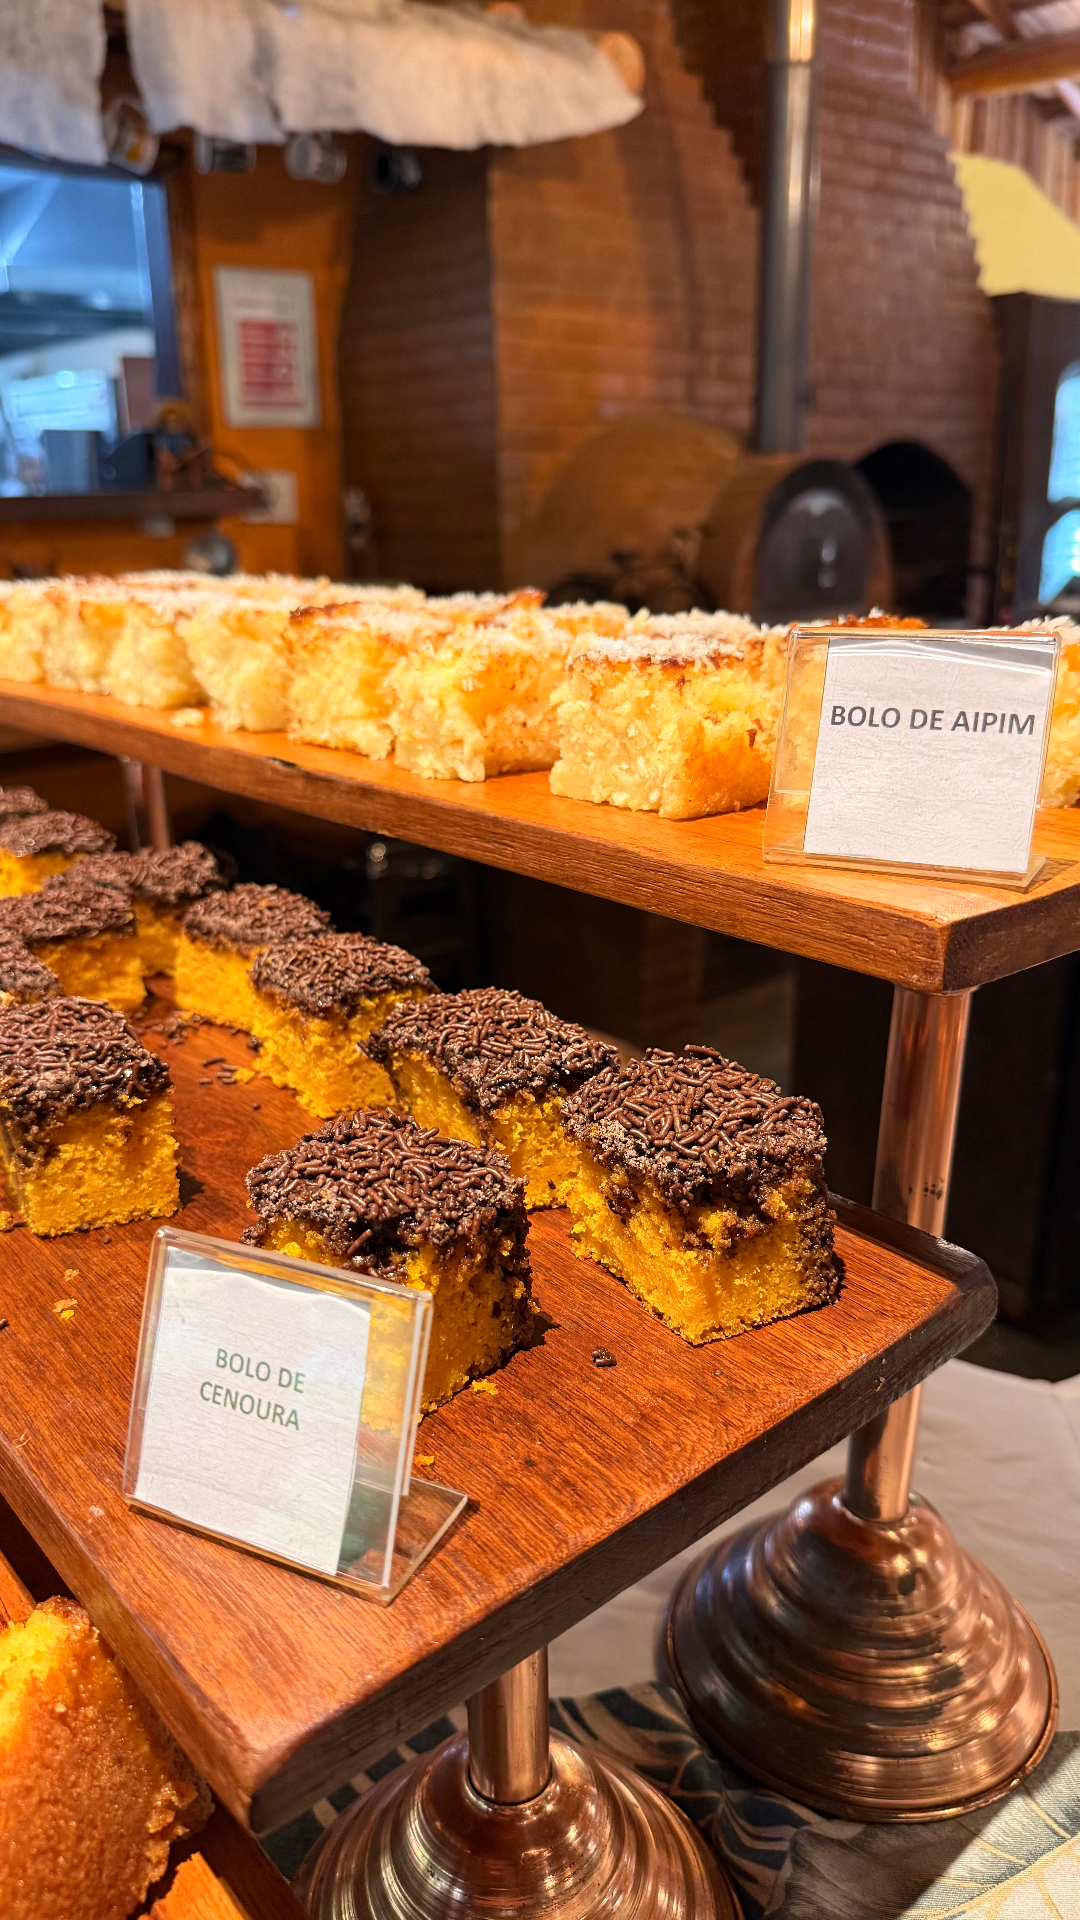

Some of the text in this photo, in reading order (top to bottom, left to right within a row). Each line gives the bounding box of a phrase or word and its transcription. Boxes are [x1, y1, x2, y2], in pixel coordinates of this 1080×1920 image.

[830, 705, 1036, 736] BOLO DE AIPIM
[215, 1348, 306, 1394] BOLO DE
[199, 1381, 300, 1431] CENOURA
